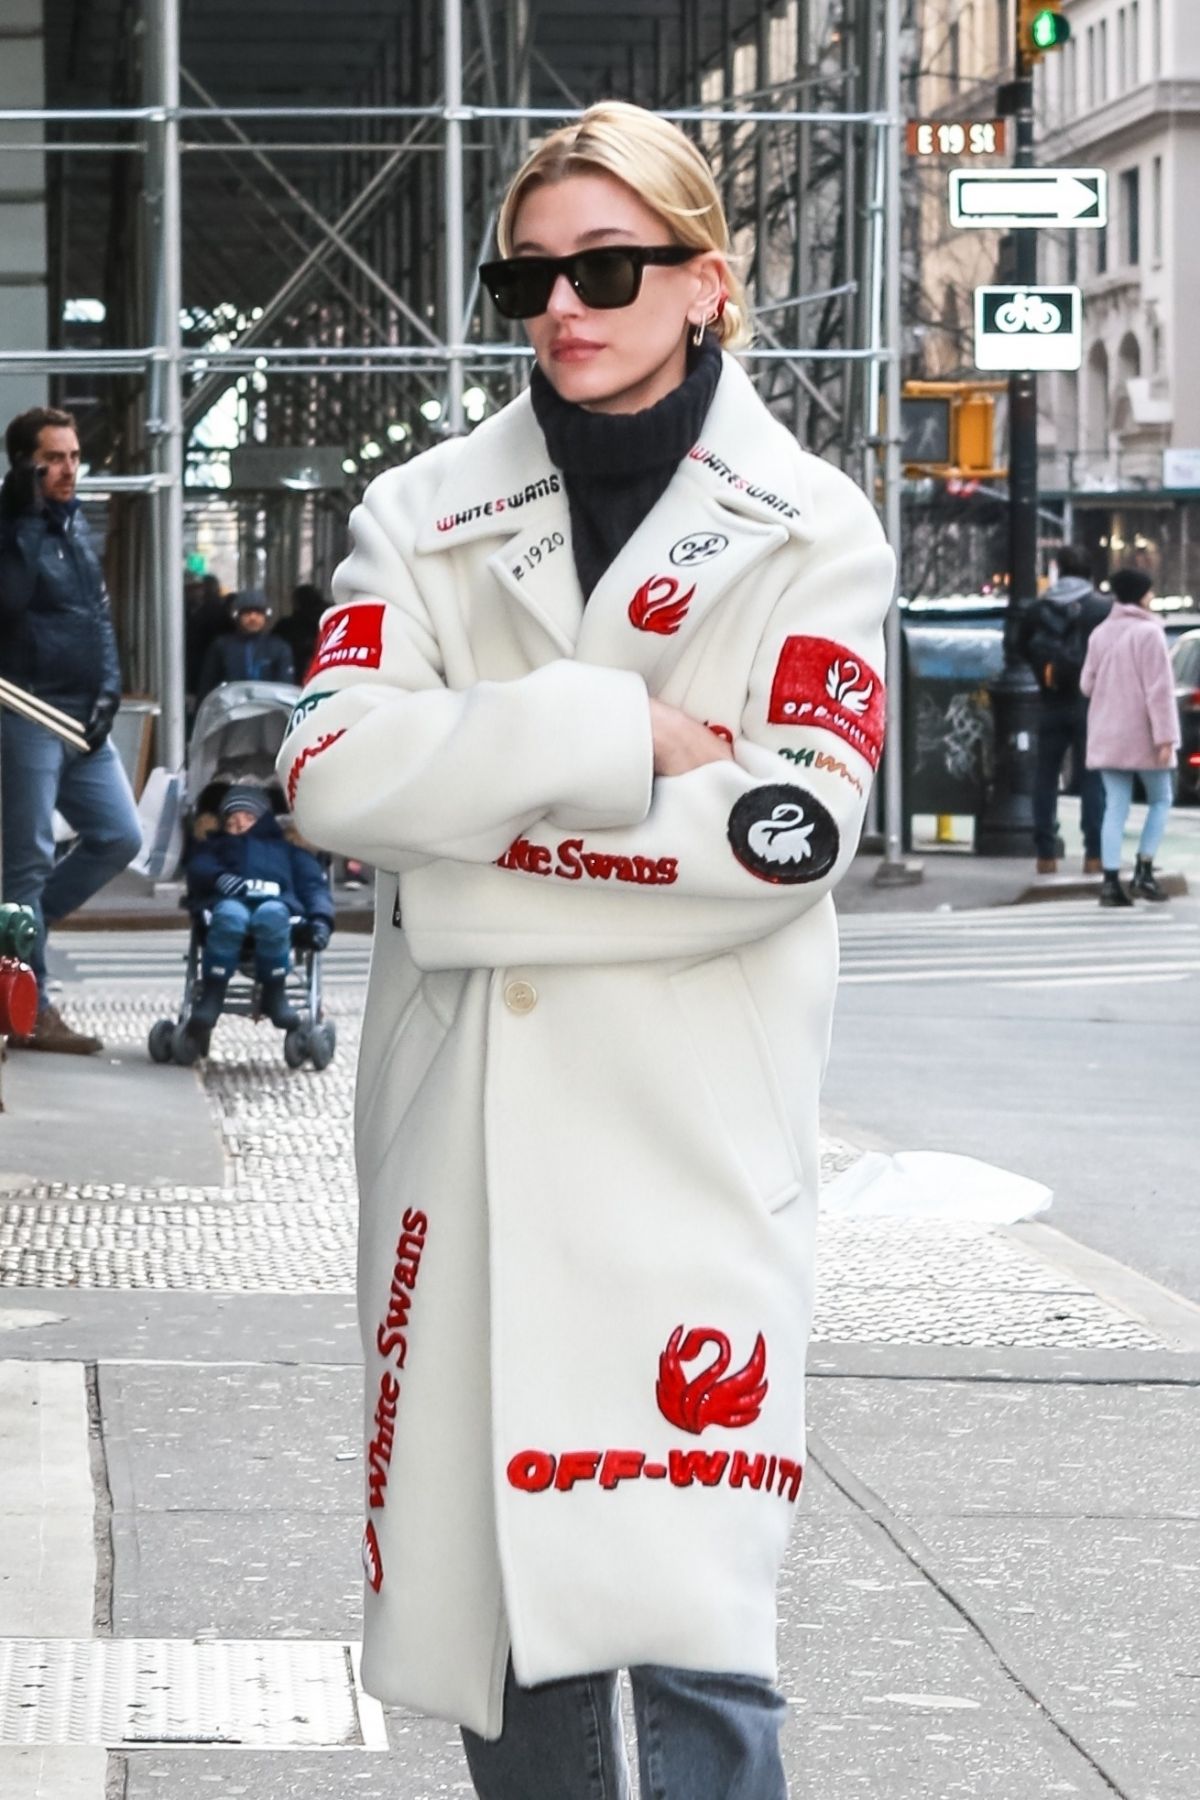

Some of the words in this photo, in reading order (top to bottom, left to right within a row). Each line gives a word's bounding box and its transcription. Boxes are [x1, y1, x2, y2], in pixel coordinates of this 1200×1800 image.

[918, 125, 934, 154] E
[938, 124, 965, 154] 19
[523, 532, 565, 570] 1920
[555, 839, 680, 885] Swans
[376, 1206, 428, 1370] Swans
[369, 1370, 401, 1509] White
